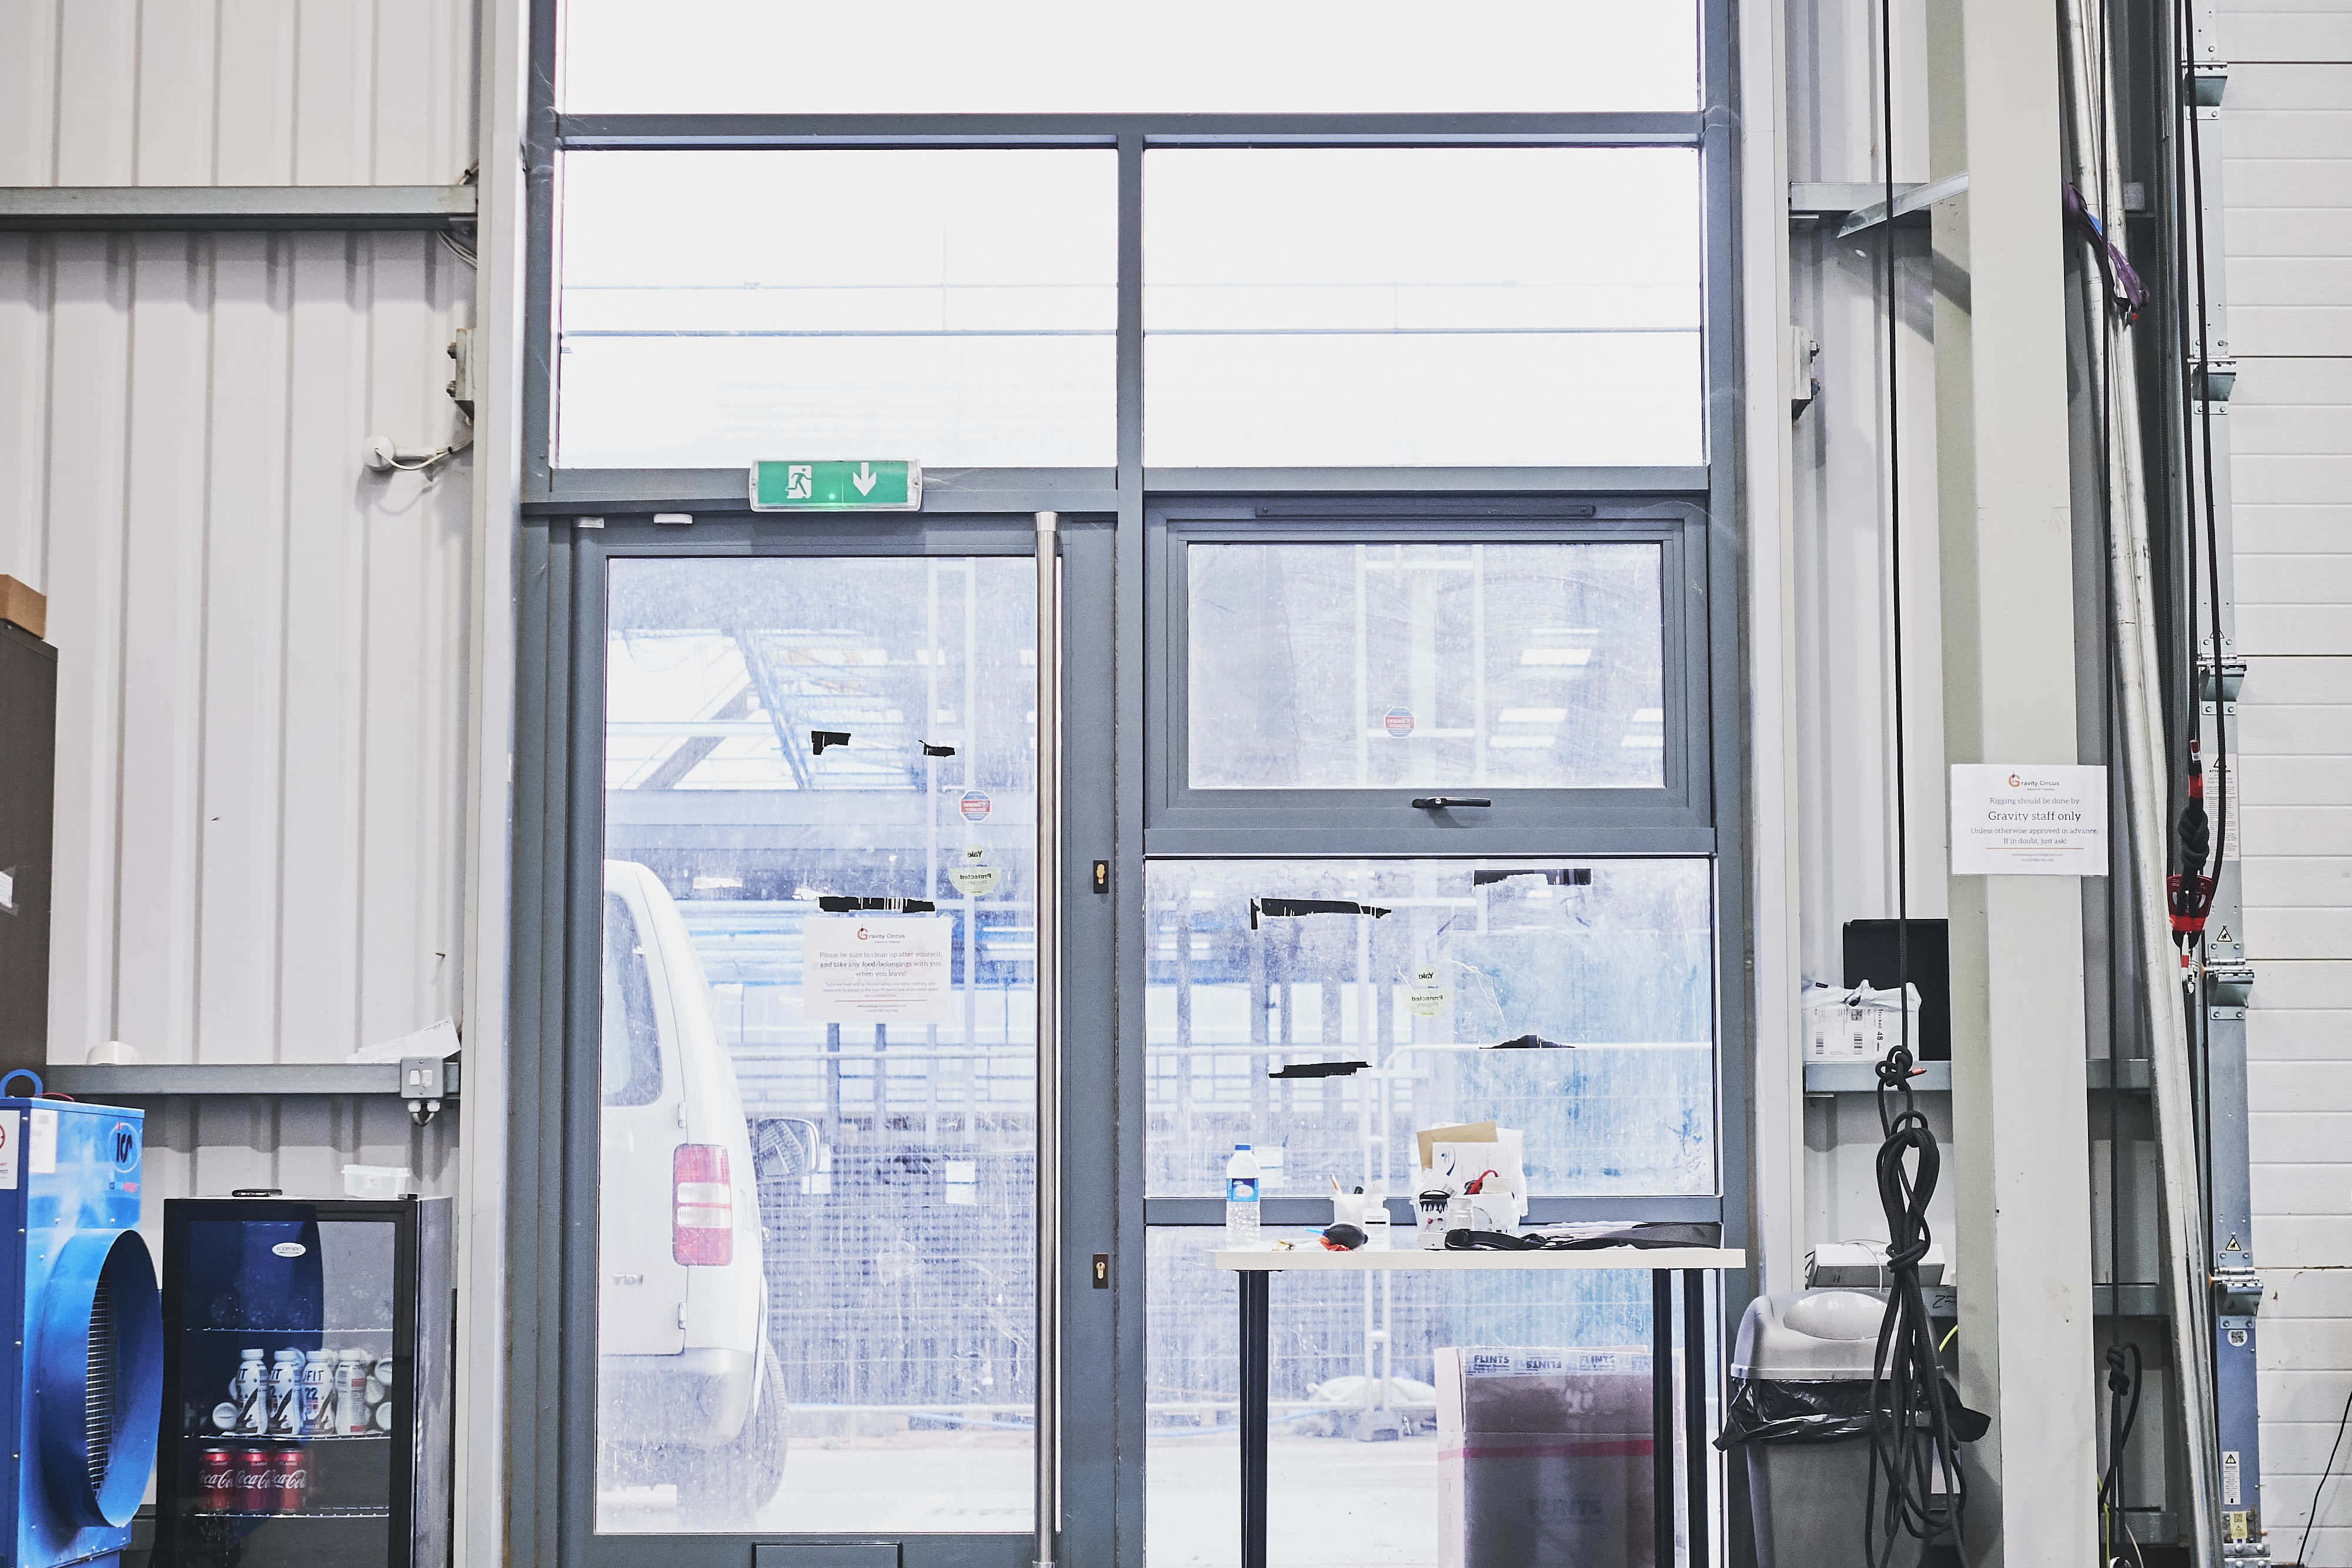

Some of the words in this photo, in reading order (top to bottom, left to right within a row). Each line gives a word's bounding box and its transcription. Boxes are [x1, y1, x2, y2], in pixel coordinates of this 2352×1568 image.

[2009, 774, 2038, 787] Gravity
[1988, 811, 2028, 822] Gravity
[2032, 811, 2054, 820] staff
[2058, 811, 2082, 822] only
[857, 928, 885, 940] Gravity
[1877, 1031, 1883, 1040] 48
[1474, 1355, 1510, 1363] FLINTS
[1526, 1360, 1562, 1369] FLINTS
[305, 1387, 318, 1400] 22
